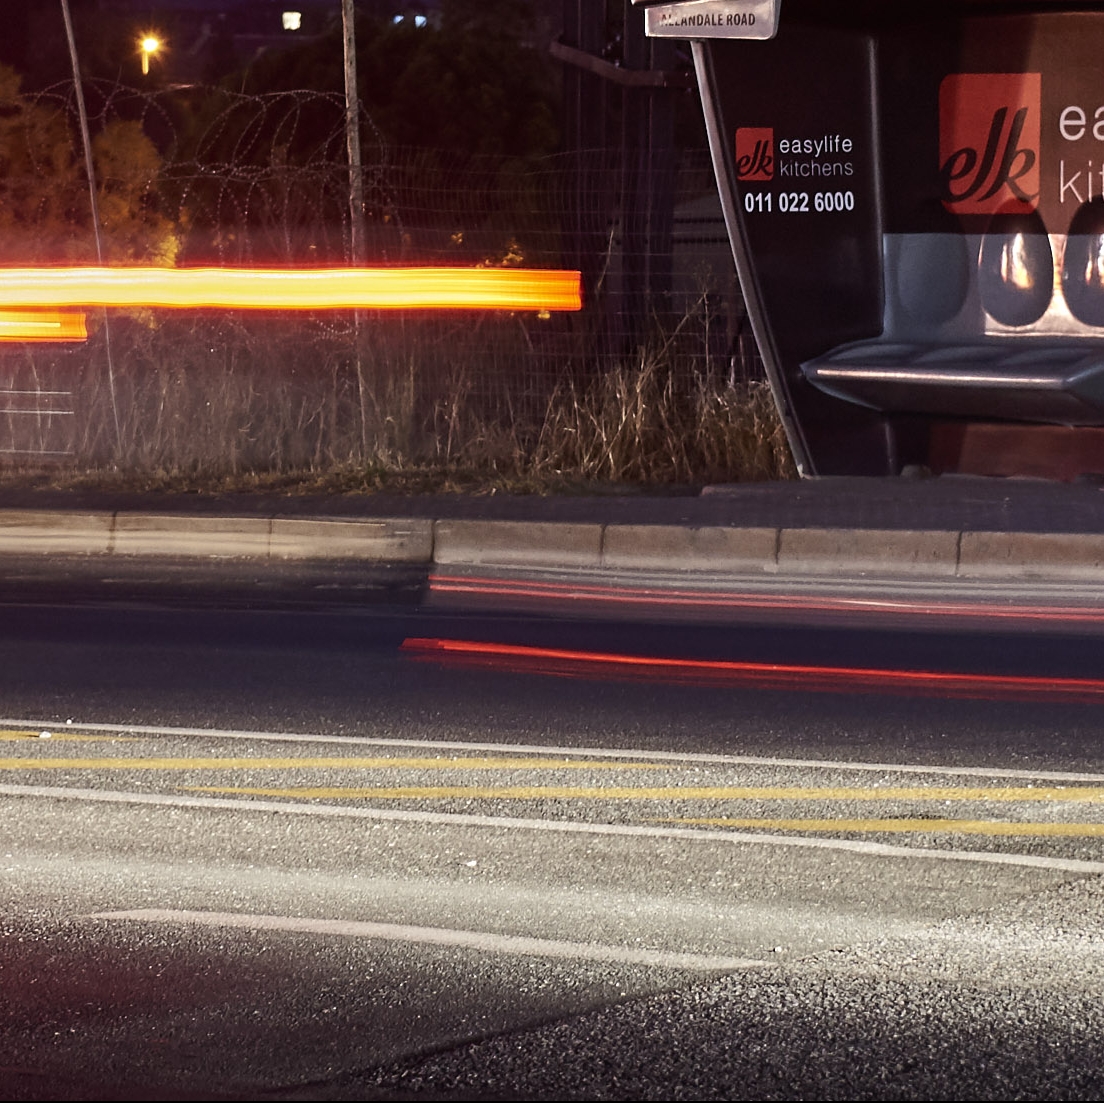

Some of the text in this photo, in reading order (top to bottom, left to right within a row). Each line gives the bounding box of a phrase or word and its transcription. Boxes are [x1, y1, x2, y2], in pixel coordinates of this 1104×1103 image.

[726, 13, 756, 26] ROAD
[779, 135, 853, 158] easylife
[780, 160, 854, 177] kitchens
[744, 191, 855, 212] 011 022 6000
